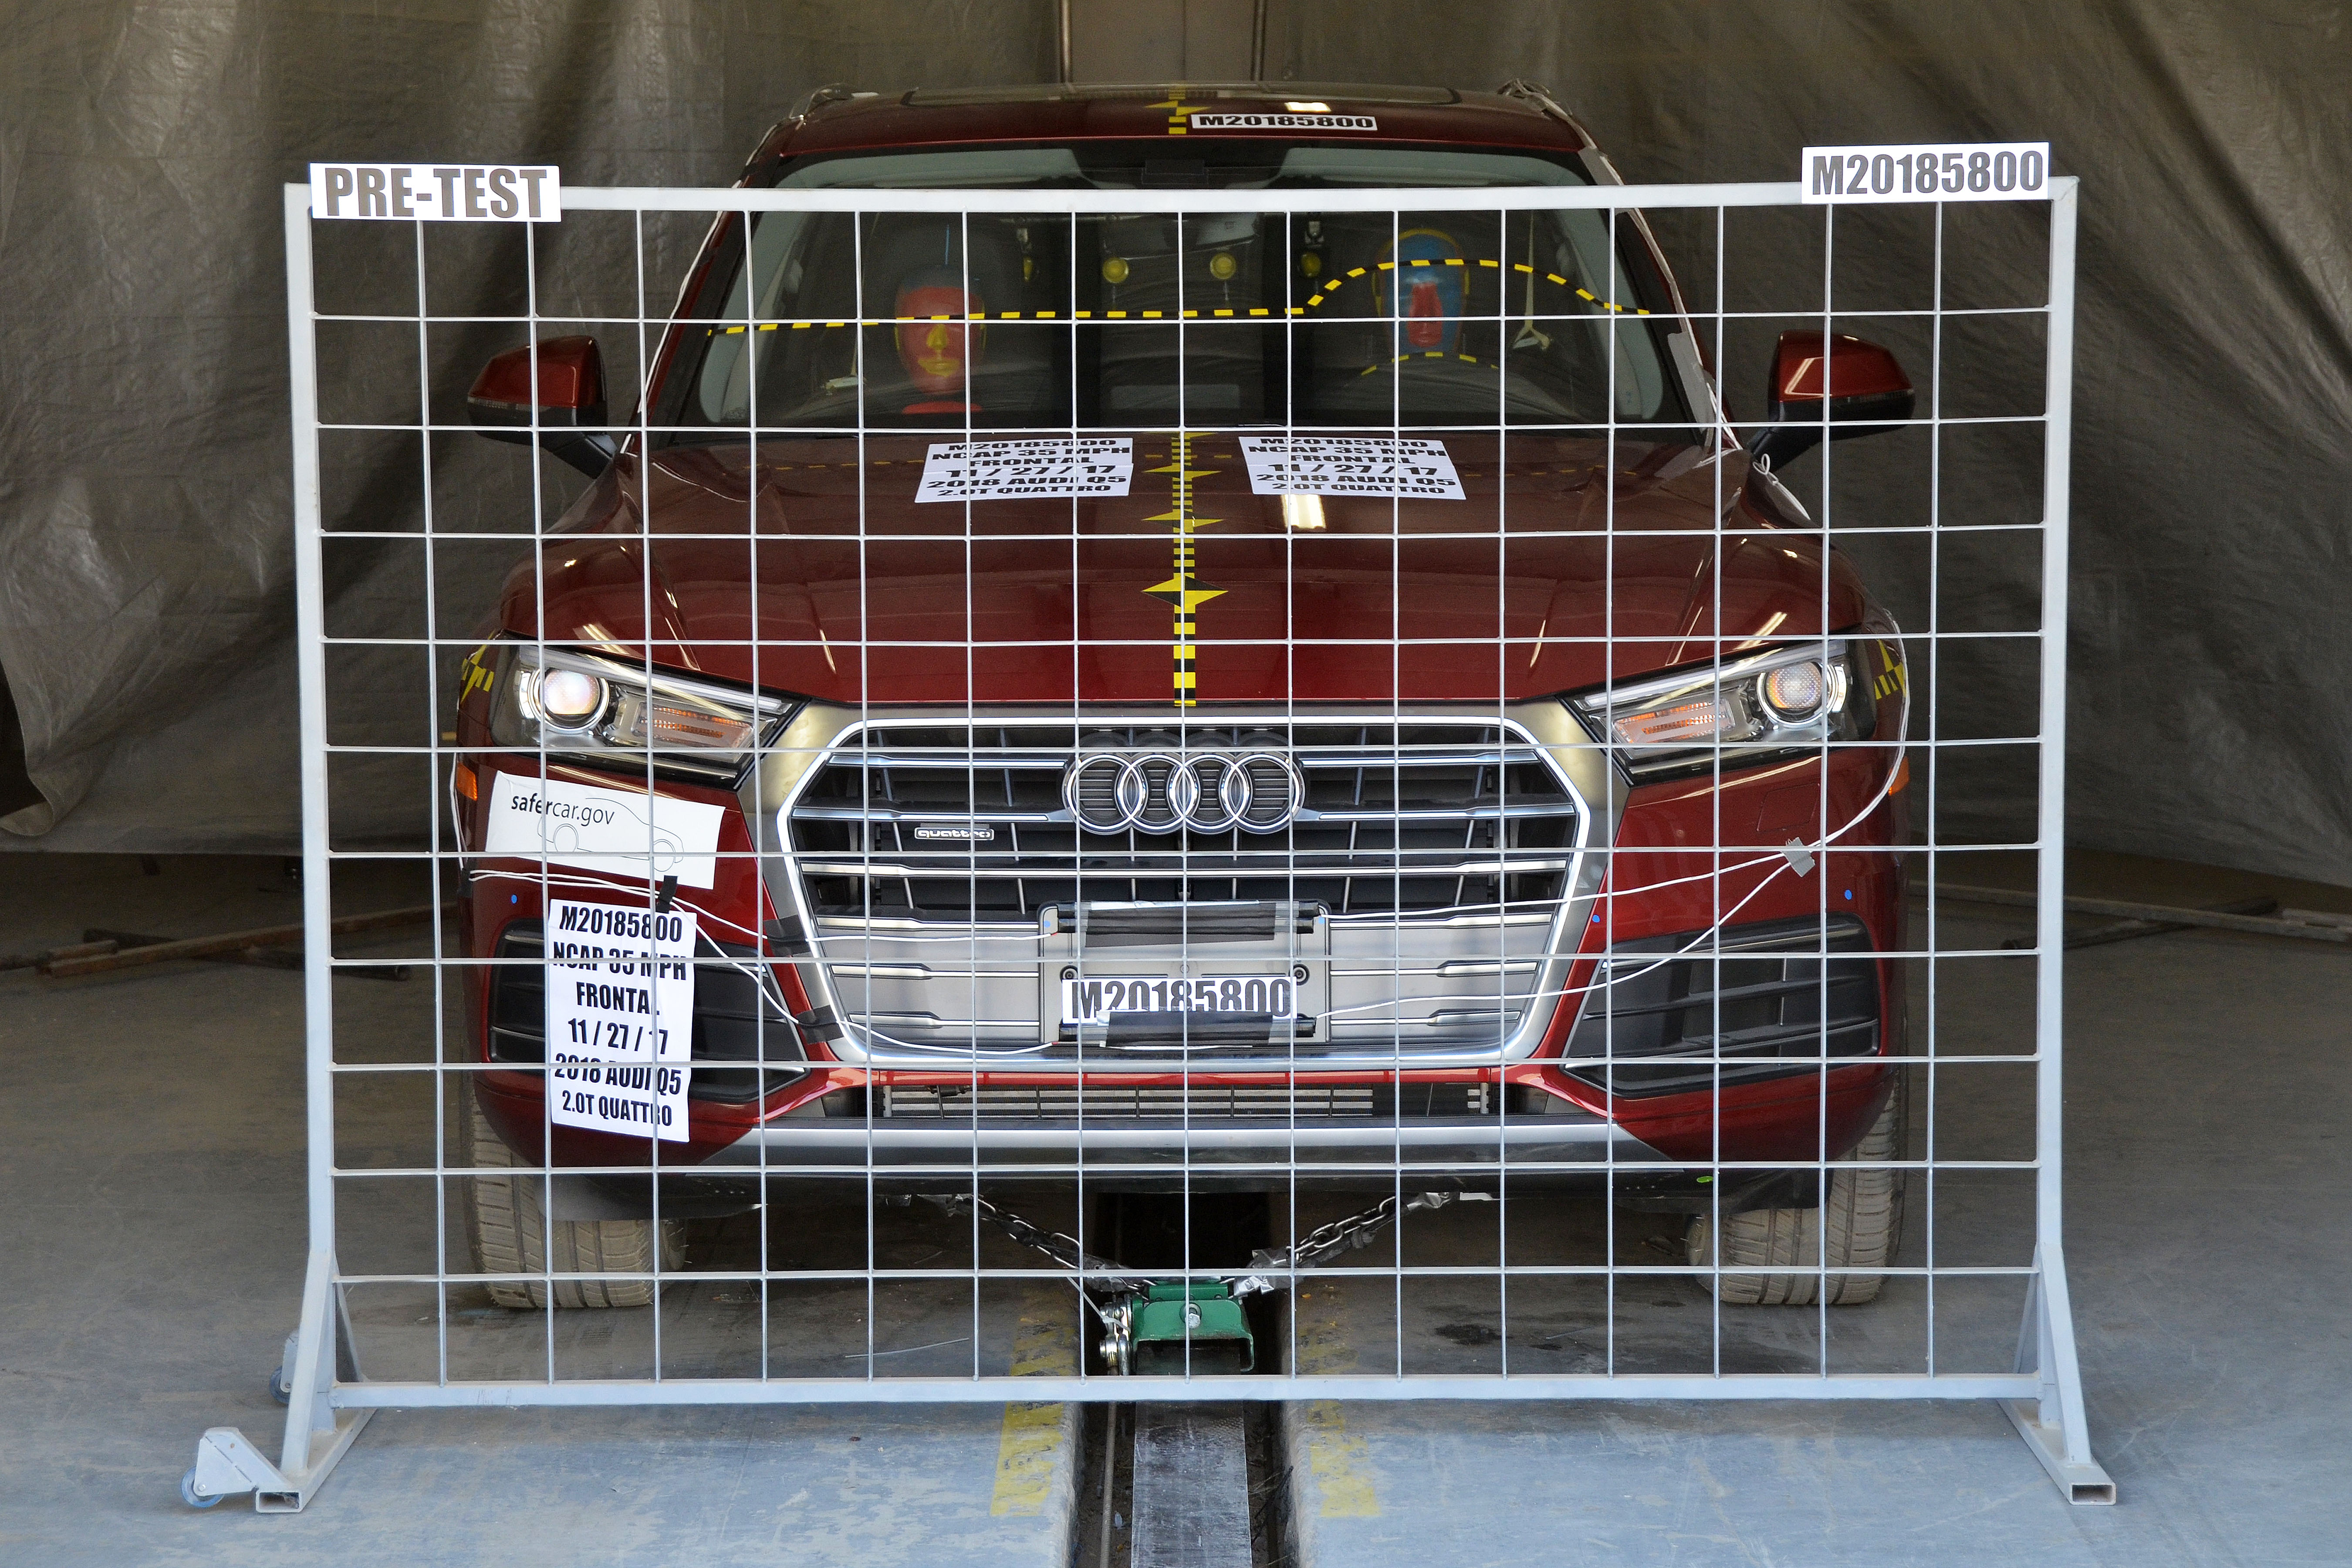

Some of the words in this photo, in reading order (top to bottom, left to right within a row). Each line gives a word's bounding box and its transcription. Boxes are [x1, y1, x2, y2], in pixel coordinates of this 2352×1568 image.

[1199, 115, 1373, 128] M20185800
[1812, 150, 2043, 195] M20185800
[325, 168, 547, 218] PRE-TEST
[948, 440, 1116, 451] M20185800
[1260, 438, 1428, 447] M20185800
[932, 451, 1010, 460] NCAP
[970, 457, 1094, 466] FRONTAL
[1289, 455, 1415, 464] FRONTAL
[946, 469, 977, 477] 11
[1011, 466, 1050, 476] 27
[1082, 465, 1115, 473] 17
[1334, 465, 1372, 473] 27
[1404, 467, 1437, 475] 17
[927, 479, 1000, 488] 2018
[1007, 476, 1079, 485] AUDI
[1416, 477, 1456, 486] Q5
[997, 485, 1111, 494] QUATTRO
[1331, 484, 1445, 493] QUATTRO
[511, 793, 615, 826] safercar.gov
[918, 829, 990, 838] quattro
[559, 906, 683, 942] M20185800
[553, 941, 603, 971] NCAP
[609, 948, 634, 975] 35
[1071, 979, 1291, 1019] M20185800
[568, 1018, 587, 1044] 11
[607, 1022, 629, 1049] 27
[554, 1053, 601, 1083] 2018
[605, 1060, 651, 1091] AUDI
[657, 1067, 682, 1096] Q5
[562, 1090, 594, 1115] 2.0T
[598, 1095, 672, 1126] QUATTRO
